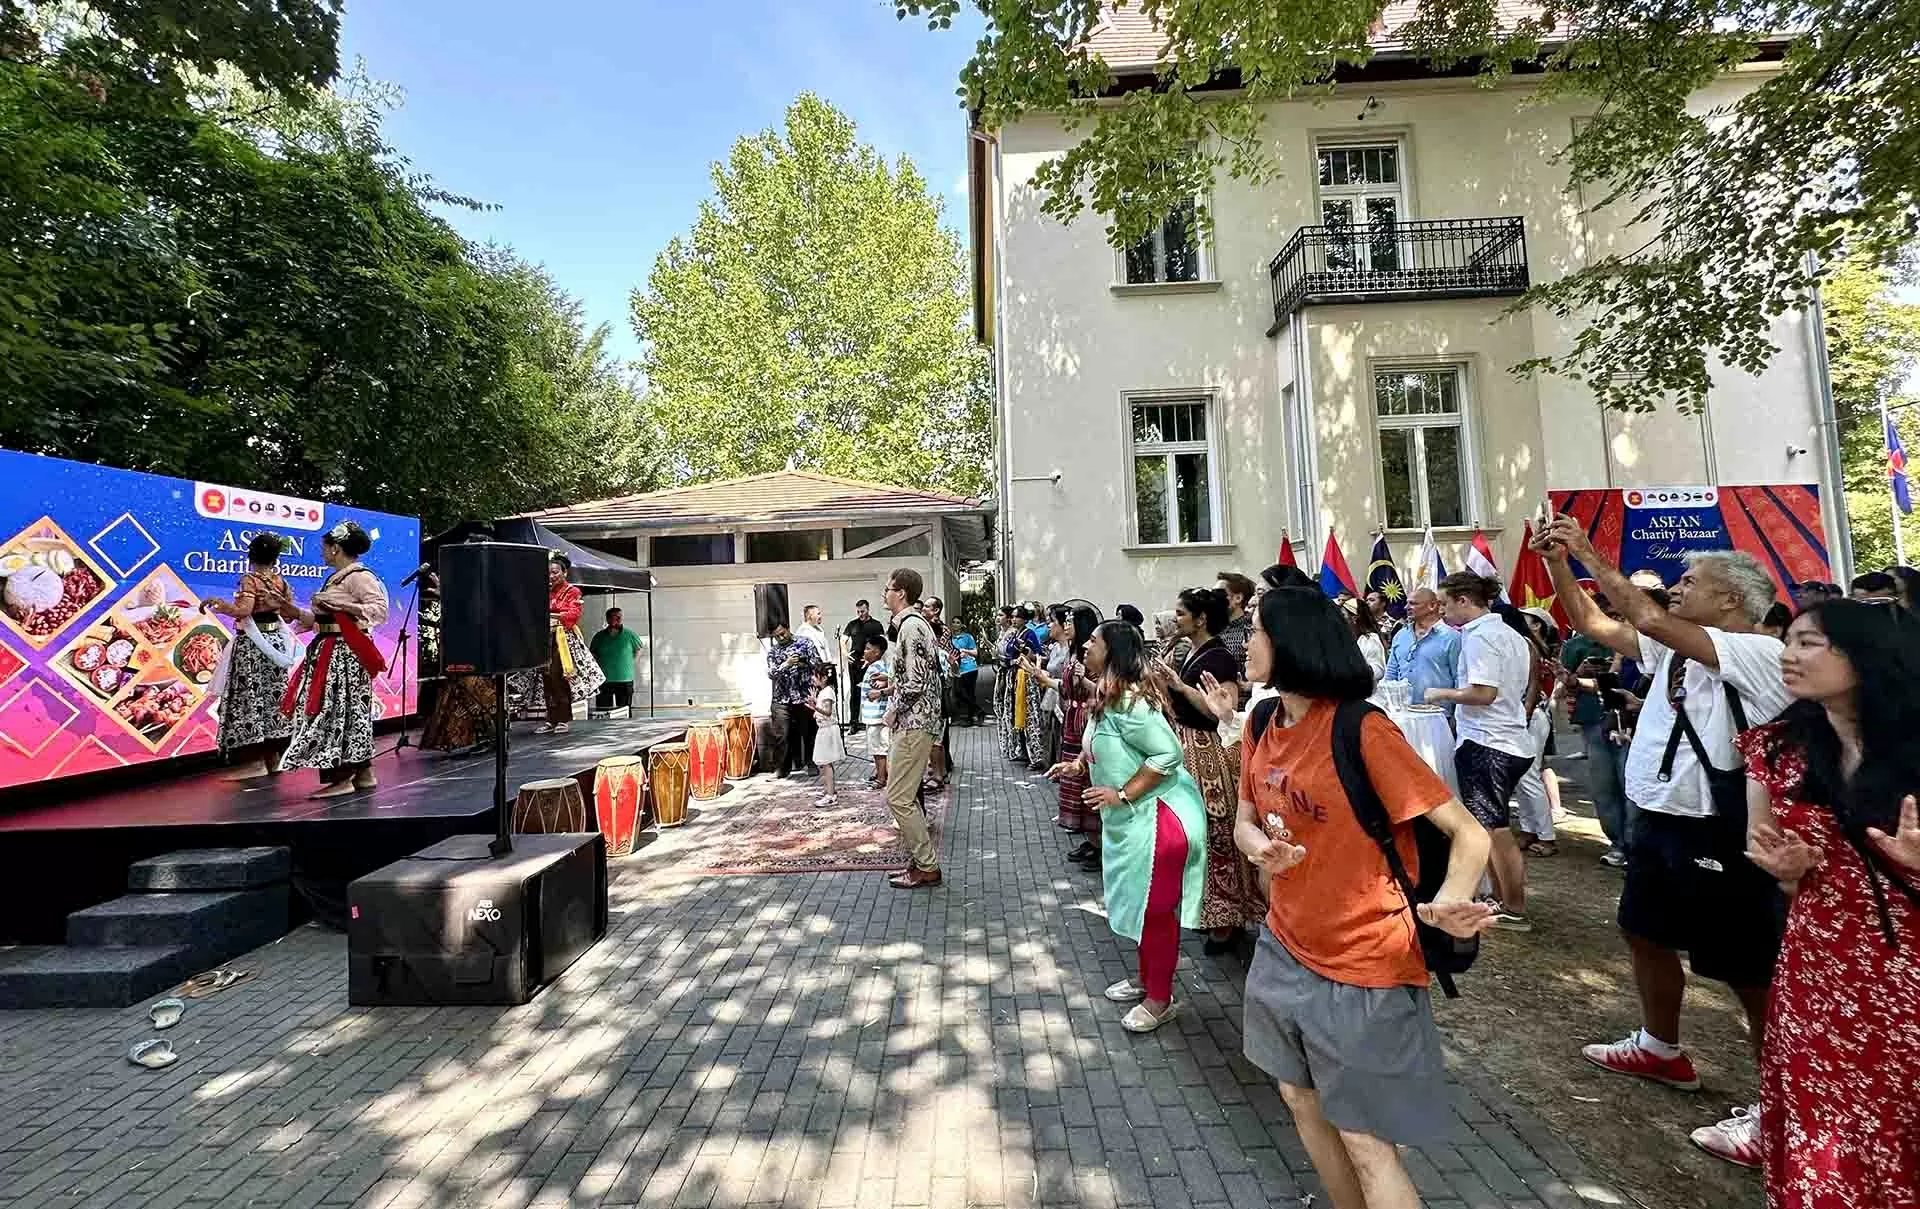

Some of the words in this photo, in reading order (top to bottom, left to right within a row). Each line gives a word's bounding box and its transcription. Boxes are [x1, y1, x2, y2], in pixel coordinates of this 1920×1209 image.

[1649, 515, 1701, 528] ASEAN
[217, 528, 305, 556] ASN
[1631, 529, 1675, 542] Charity
[1679, 528, 1719, 539] Bazaar
[184, 551, 251, 575] Charit
[467, 908, 501, 922] NEXO
